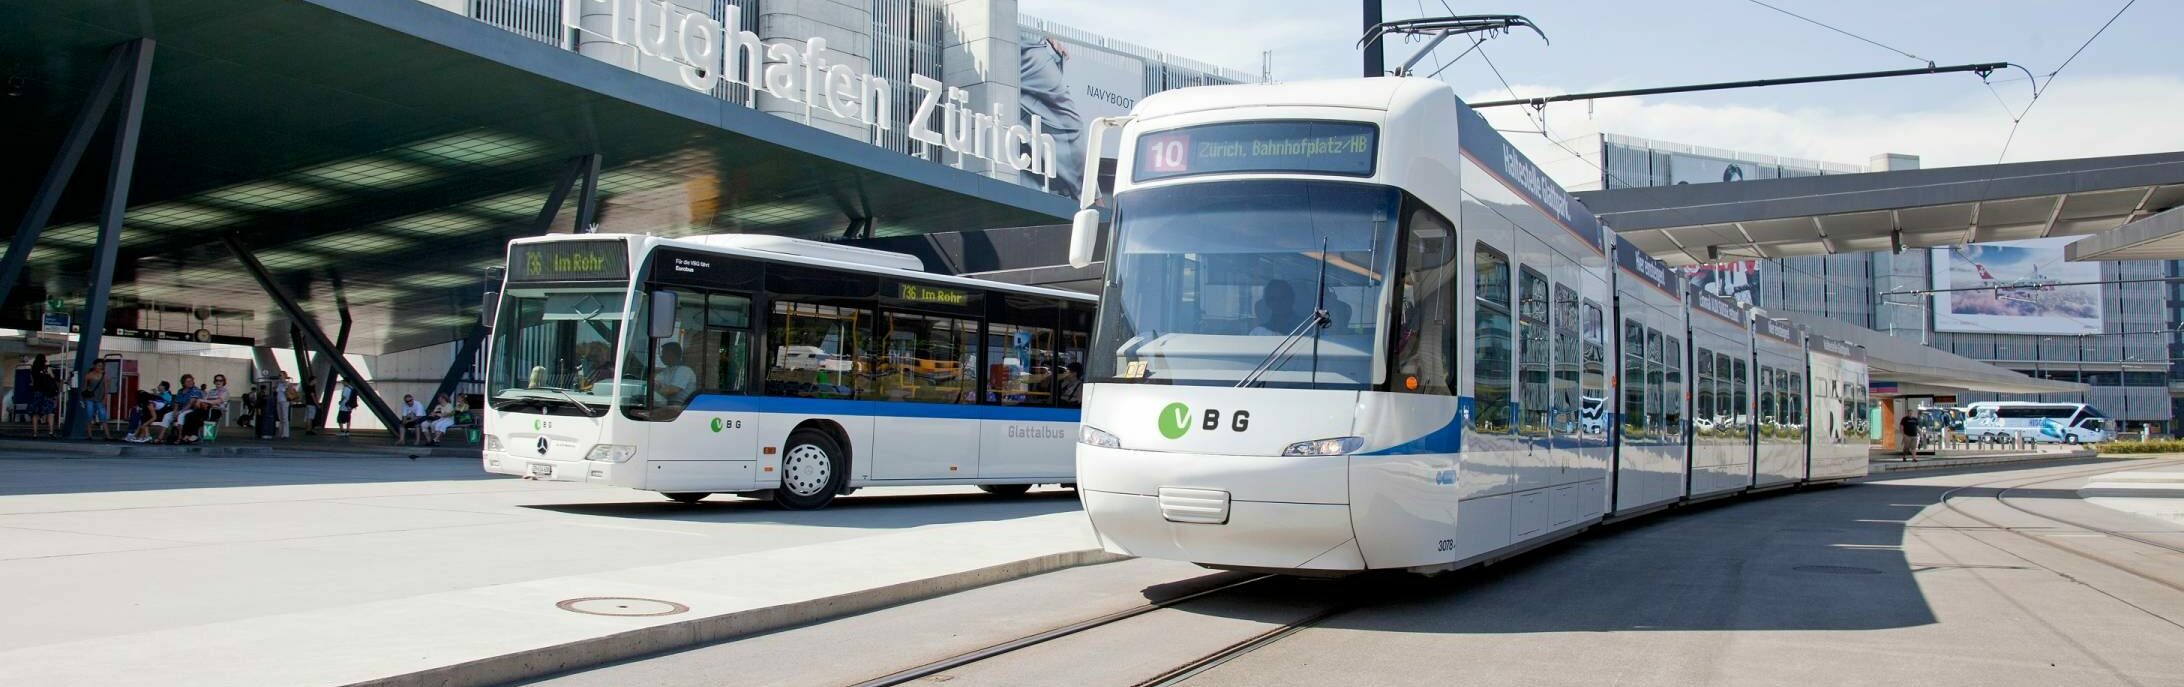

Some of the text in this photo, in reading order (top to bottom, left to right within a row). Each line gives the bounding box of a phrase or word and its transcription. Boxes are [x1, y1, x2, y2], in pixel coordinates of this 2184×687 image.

[1086, 84, 1135, 110] NAVYBOOT
[909, 73, 1056, 178] Zürich
[1151, 141, 1184, 168] 10
[1252, 135, 1367, 158] Bahnhofplatz/HB
[553, 254, 570, 272] Im
[573, 252, 604, 272] Rohr
[902, 284, 962, 303] 736 Im Rohr
[1008, 425, 1065, 439] Glattalbus
[1438, 539, 1454, 552] 3078
